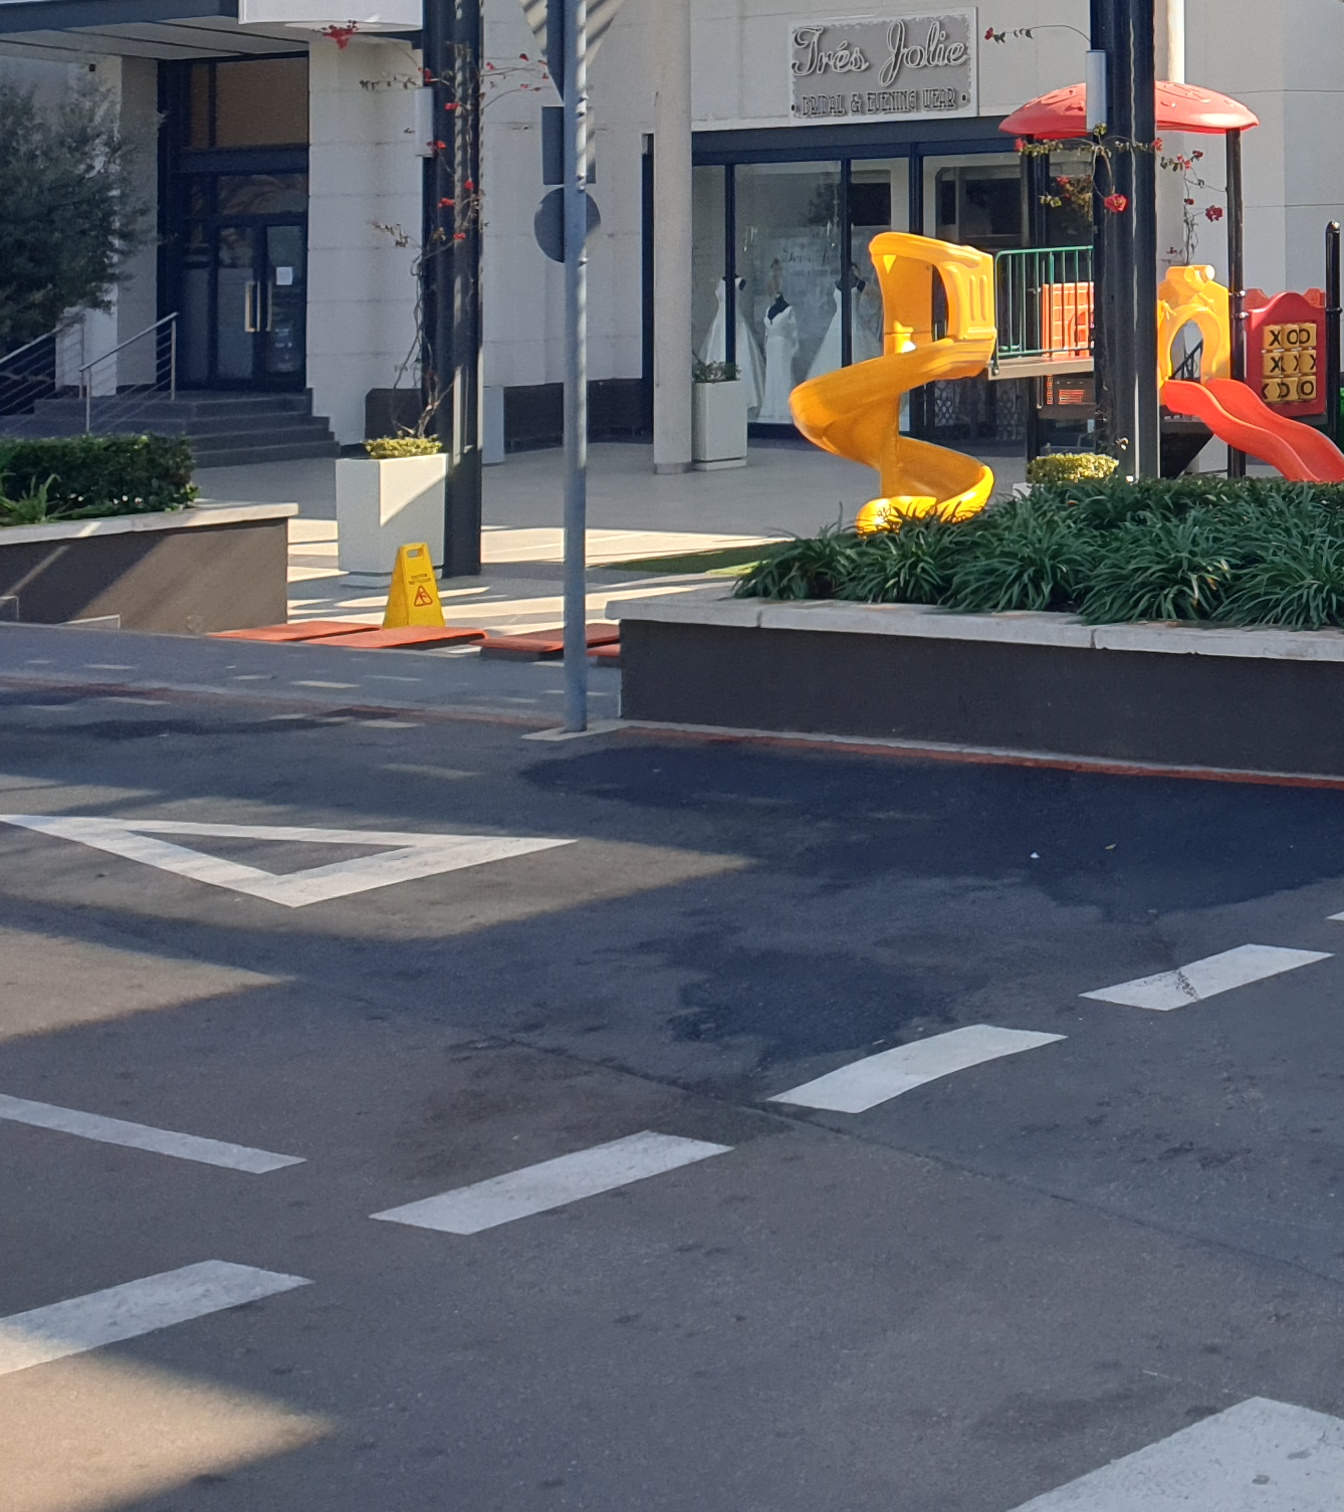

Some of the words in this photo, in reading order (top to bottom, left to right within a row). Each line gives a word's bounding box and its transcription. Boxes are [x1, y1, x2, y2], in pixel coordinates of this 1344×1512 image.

[791, 25, 870, 76] Trés
[878, 19, 971, 88] Jolie
[801, 94, 846, 116] BRIDAL
[850, 93, 862, 114] &
[866, 90, 918, 113] EVENING
[921, 87, 958, 109] WEAR
